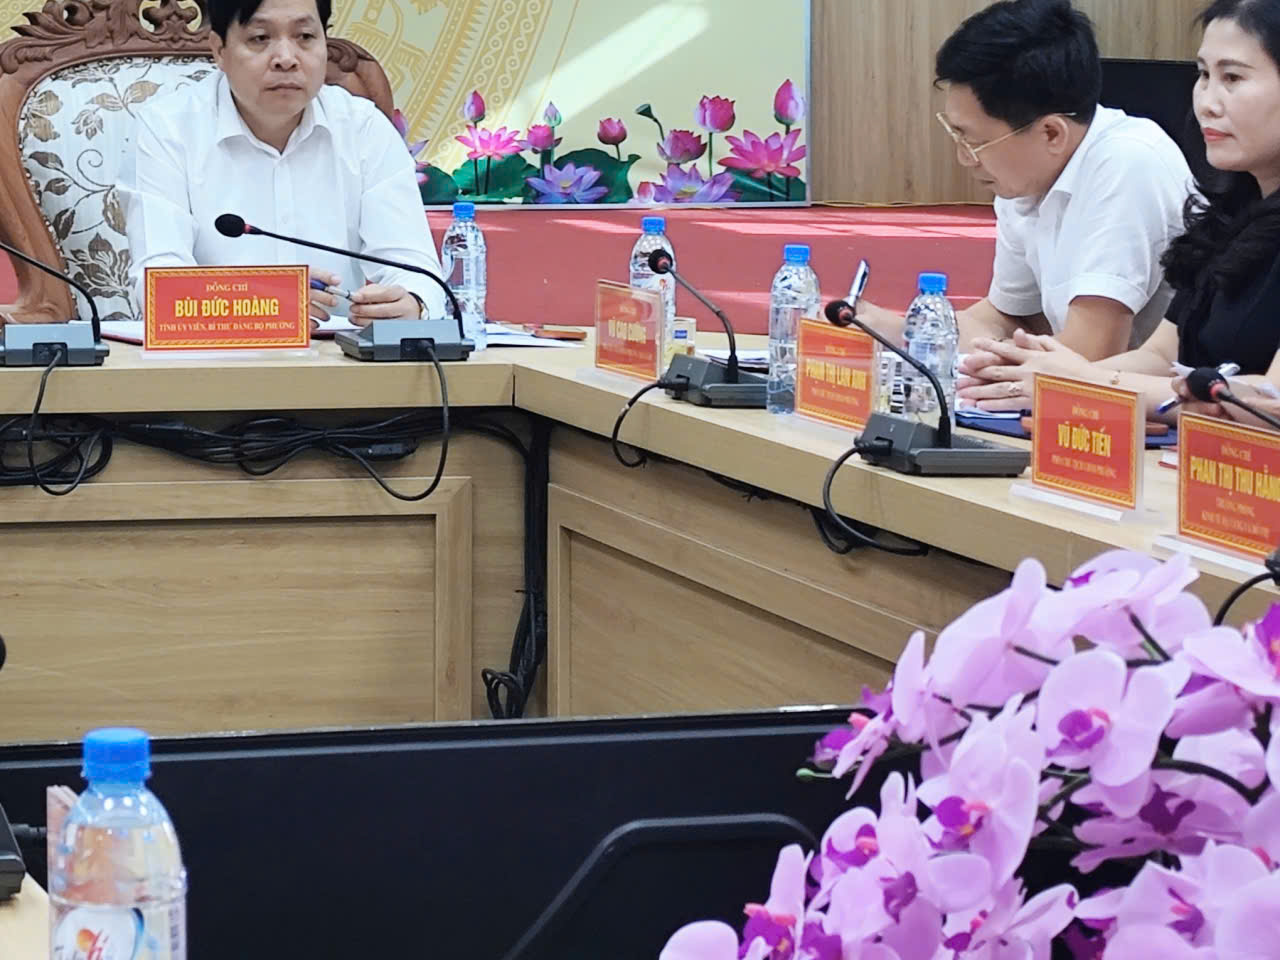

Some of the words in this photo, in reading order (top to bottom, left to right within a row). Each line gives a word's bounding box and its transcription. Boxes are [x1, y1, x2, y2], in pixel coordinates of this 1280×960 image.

[175, 296, 198, 318] BÙI
[201, 296, 229, 317] ĐỨC
[233, 295, 280, 316] HOÀNG
